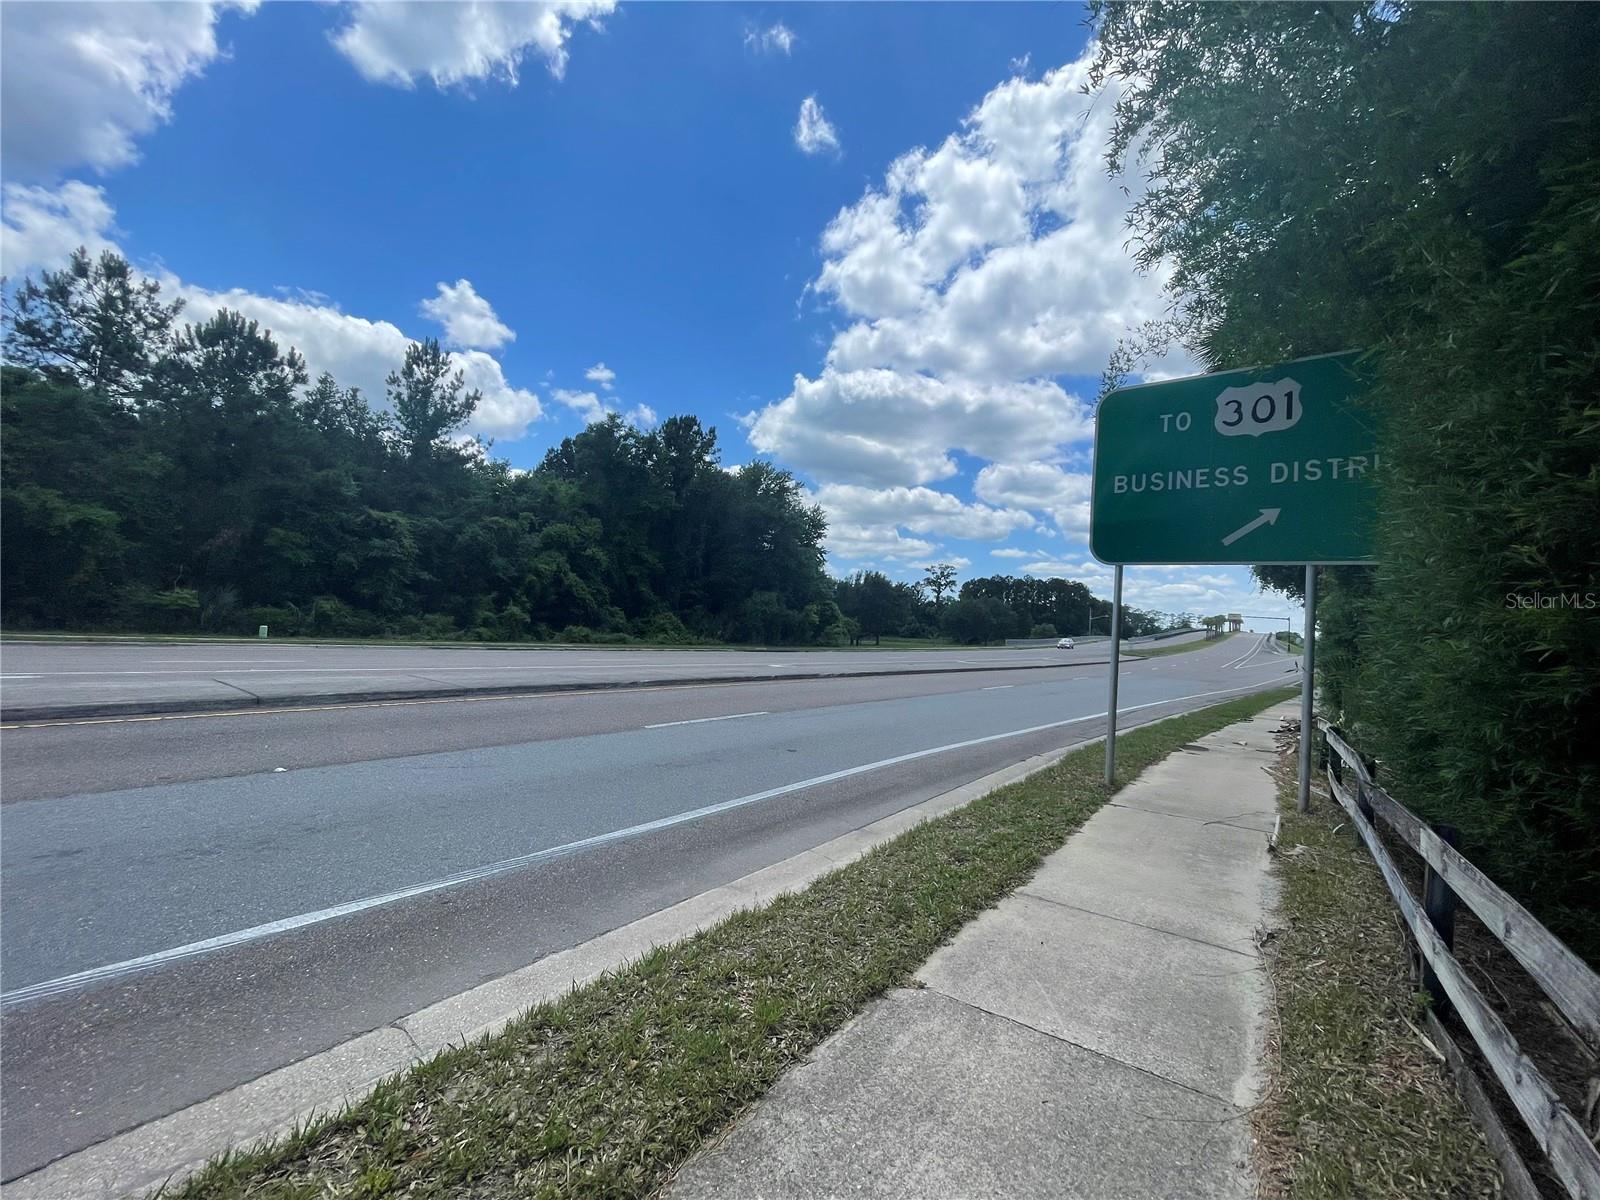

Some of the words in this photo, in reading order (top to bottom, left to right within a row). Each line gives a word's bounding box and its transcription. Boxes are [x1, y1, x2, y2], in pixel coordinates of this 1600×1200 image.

[1160, 412, 1192, 433] TO
[1222, 391, 1294, 428] 301
[1114, 465, 1249, 494] BUSINESS
